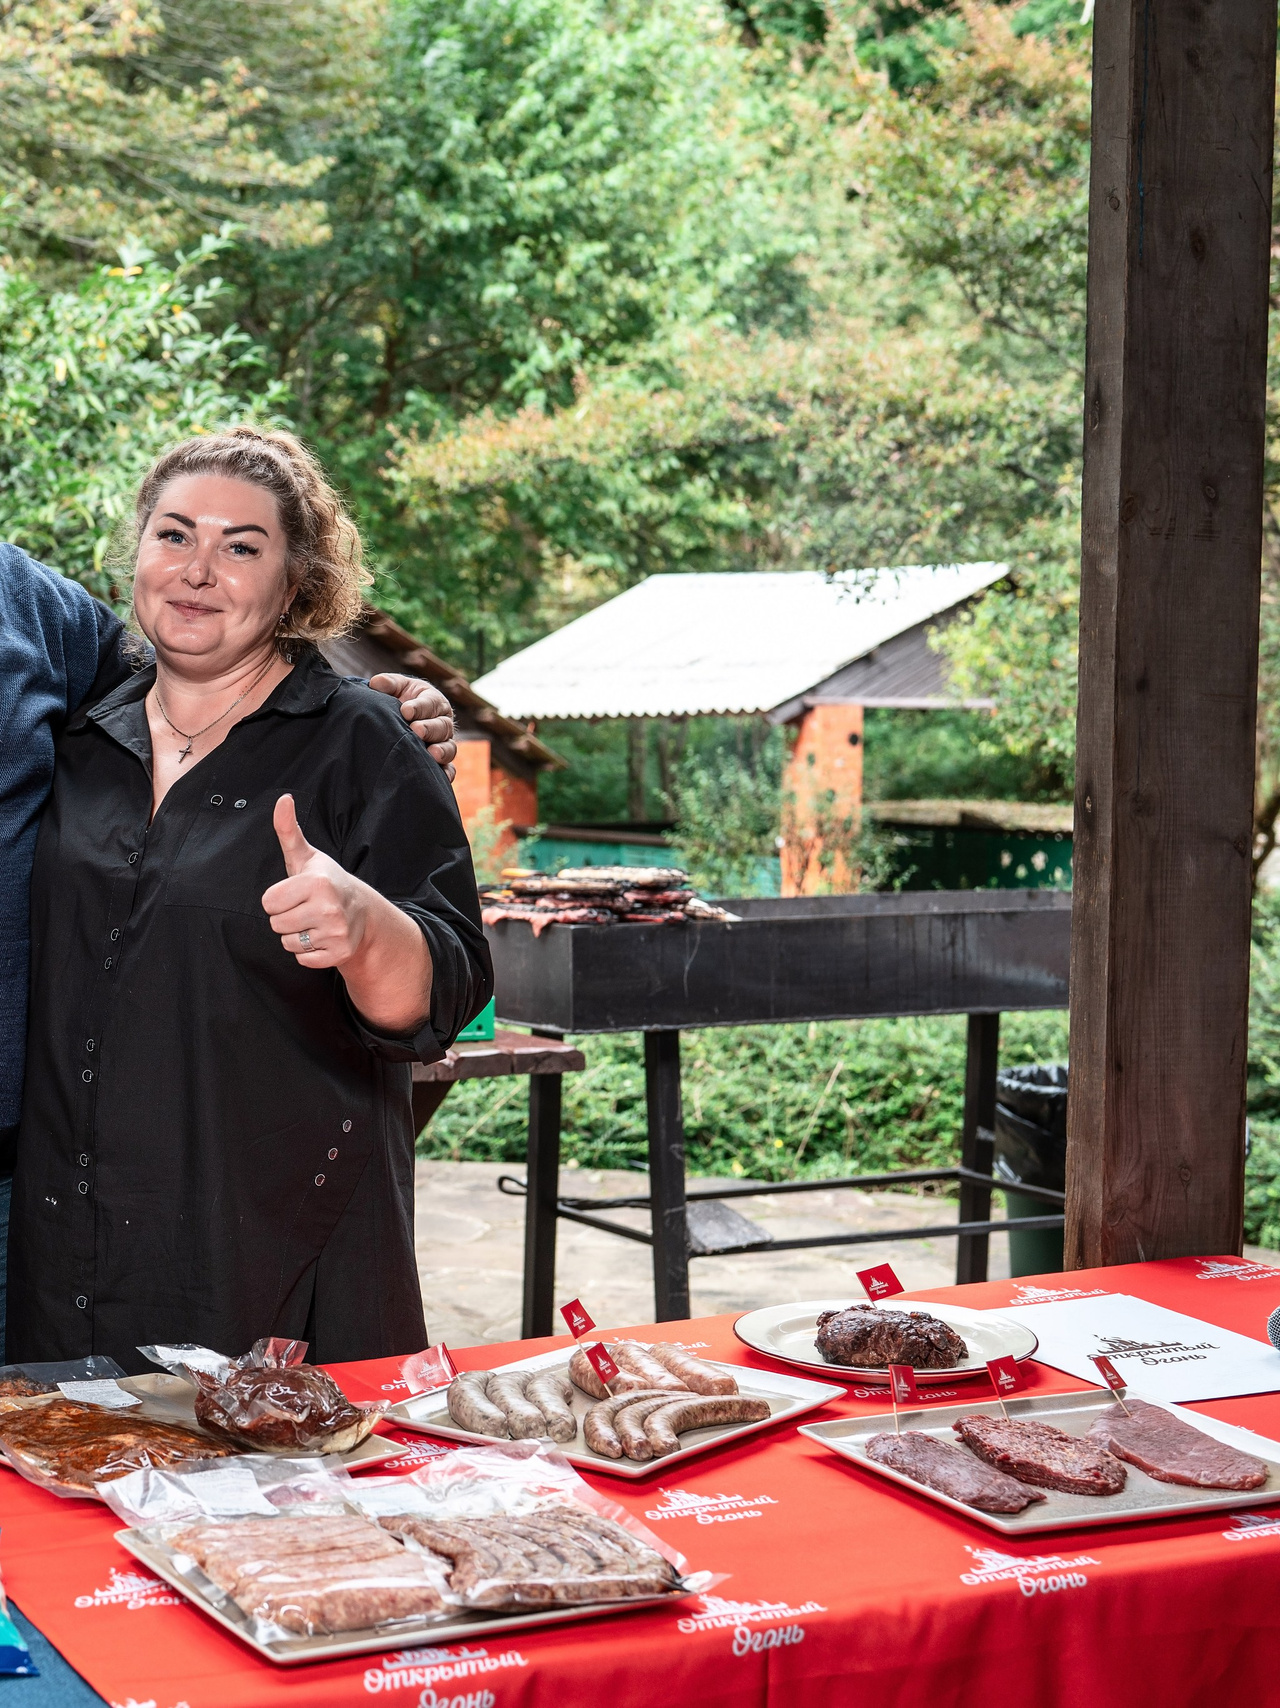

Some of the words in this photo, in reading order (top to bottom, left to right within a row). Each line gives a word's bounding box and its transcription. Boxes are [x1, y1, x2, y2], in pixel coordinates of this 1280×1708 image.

[1140, 1353, 1207, 1366] Огонь
[917, 1391, 957, 1400] гонь
[645, 1495, 779, 1520] Открытый
[695, 1510, 763, 1524] Огонь
[959, 1555, 1102, 1585] Открытый
[1017, 1572, 1088, 1597] Огонь
[677, 1601, 829, 1634] Открытый
[732, 1624, 805, 1657] Огонь
[363, 1650, 529, 1694] Открытый
[417, 1688, 495, 1708] Огонь
